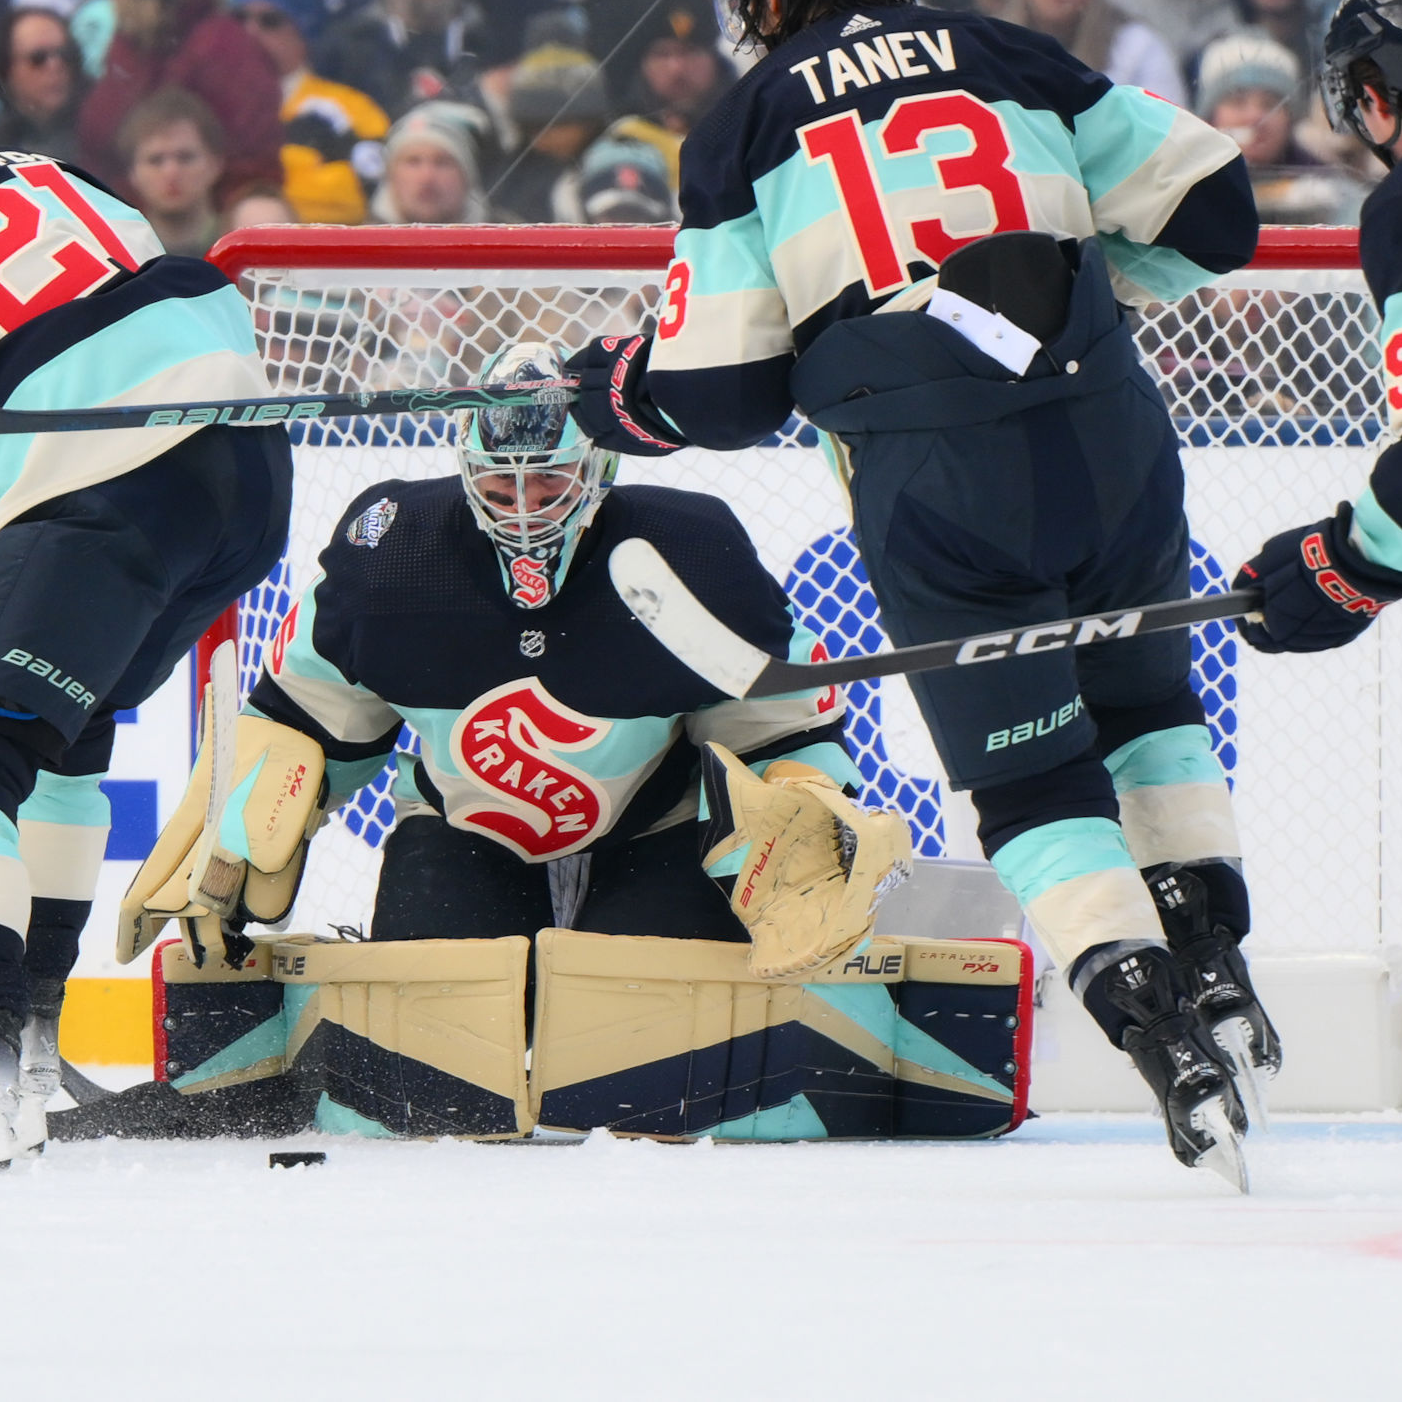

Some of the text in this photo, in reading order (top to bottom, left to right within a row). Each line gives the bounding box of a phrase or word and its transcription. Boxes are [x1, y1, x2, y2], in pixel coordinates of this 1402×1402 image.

[789, 29, 957, 104] TANEV
[795, 89, 1031, 299] 13
[656, 259, 694, 342] 3
[144, 401, 326, 427] BAUER
[1301, 532, 1392, 618] CCM
[954, 610, 1143, 666] CCM
[0, 647, 96, 710] BAUER
[985, 693, 1085, 752] BAUER
[471, 718, 589, 834] KRAKEN
[739, 836, 777, 909] TRUE
[827, 954, 903, 976] RUE
